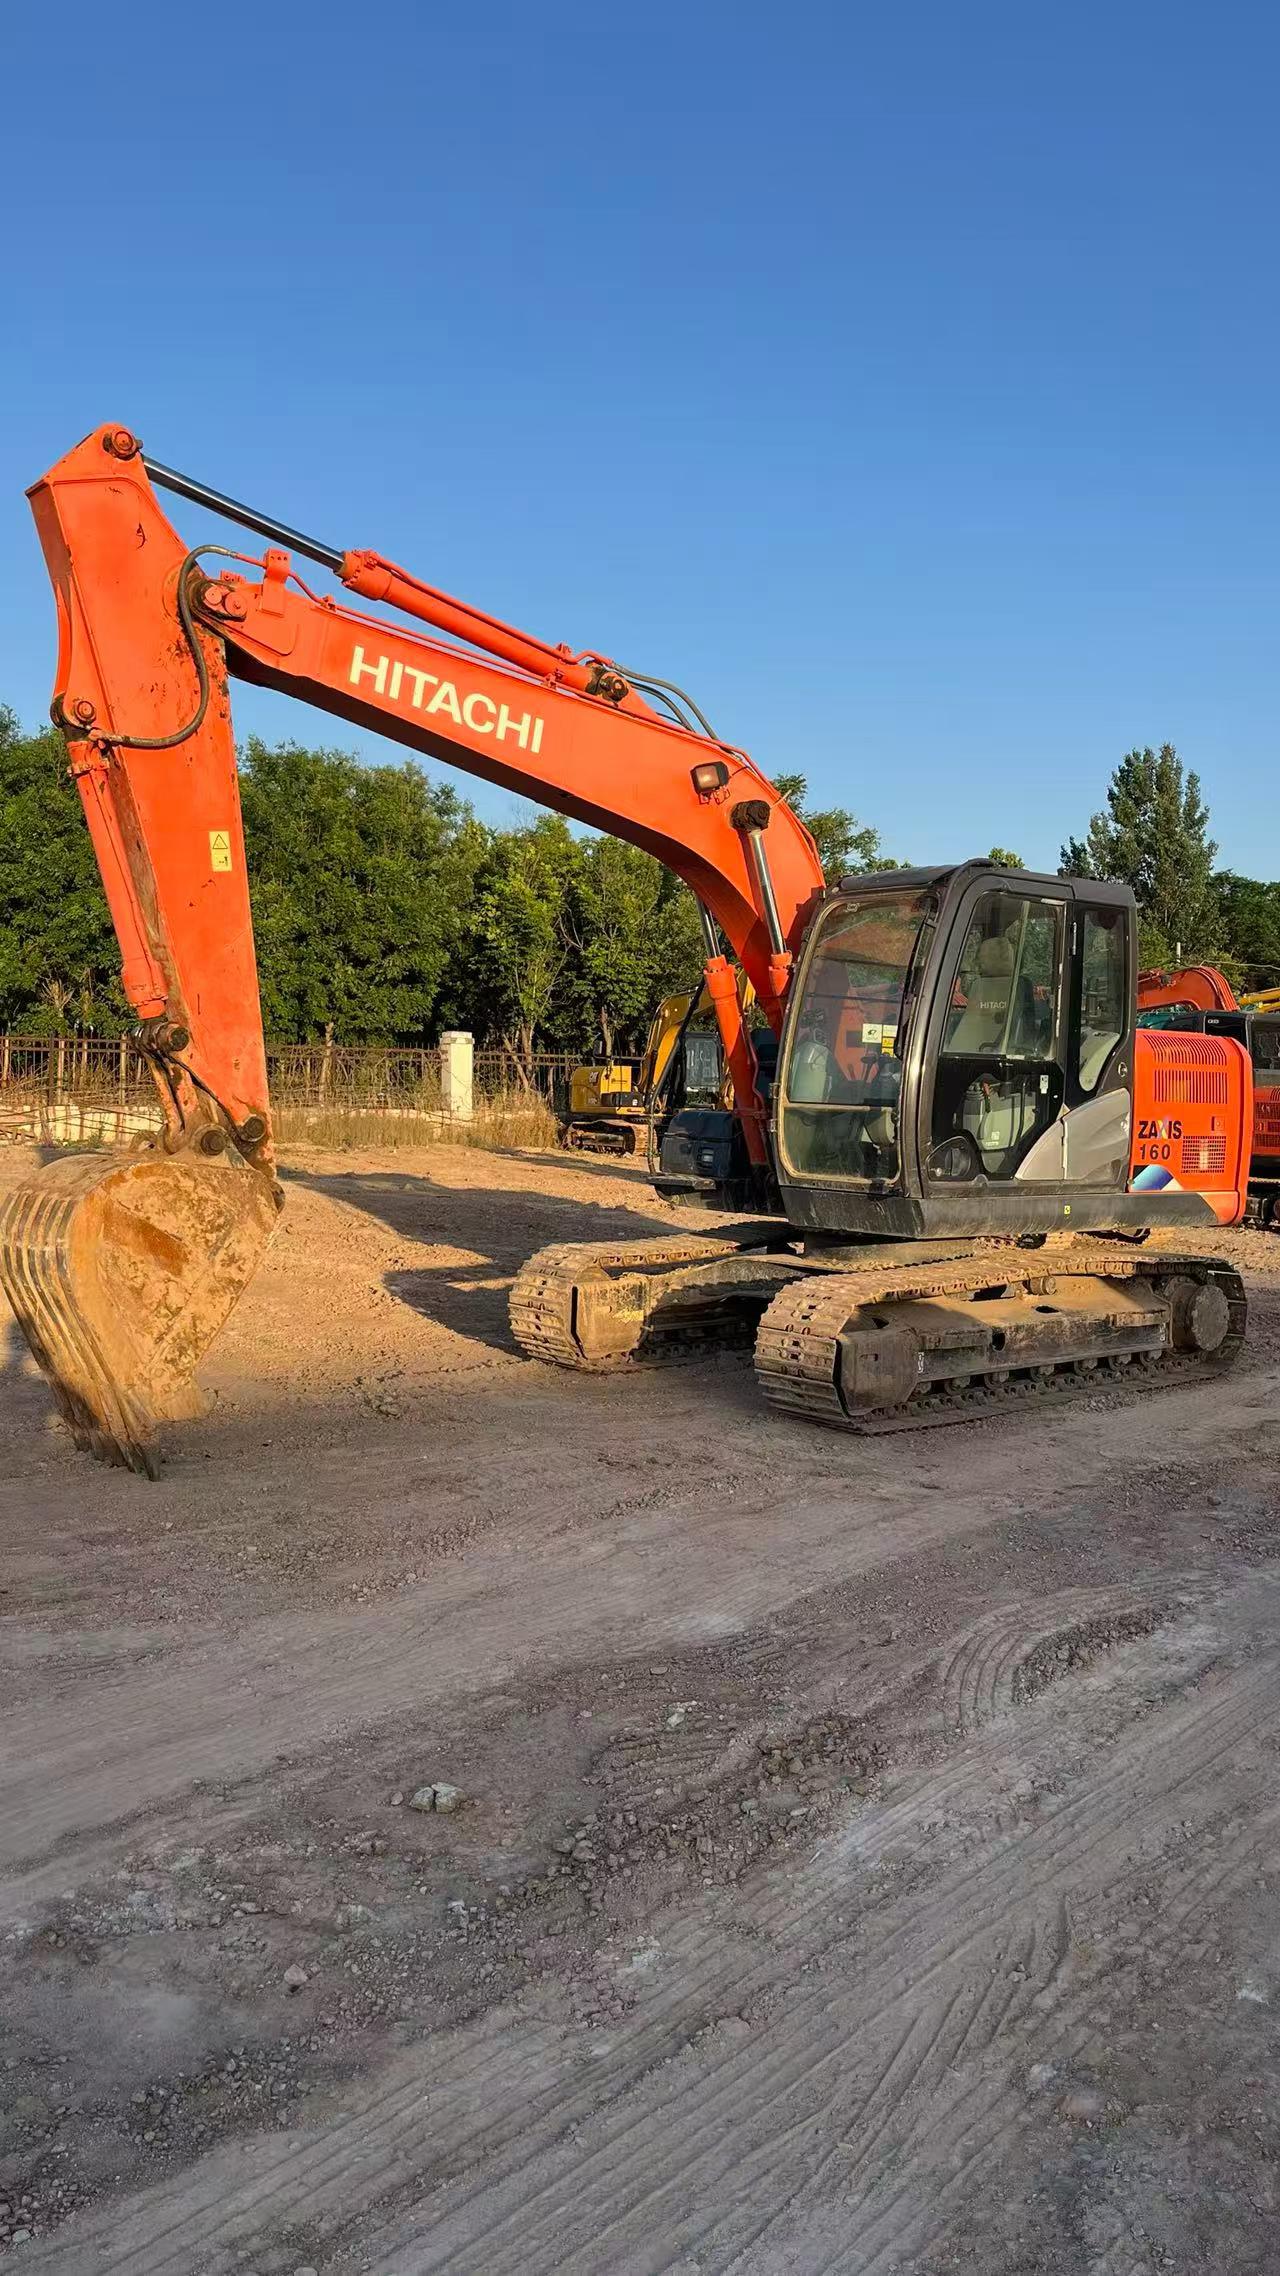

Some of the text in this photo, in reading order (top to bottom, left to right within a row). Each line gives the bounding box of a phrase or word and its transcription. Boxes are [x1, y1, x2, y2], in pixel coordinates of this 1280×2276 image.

[349, 645, 545, 755] HITACHI
[980, 1001, 1007, 1009] HITAC
[1138, 1119, 1182, 1140] ZAXIS
[1140, 1143, 1171, 1160] 160
